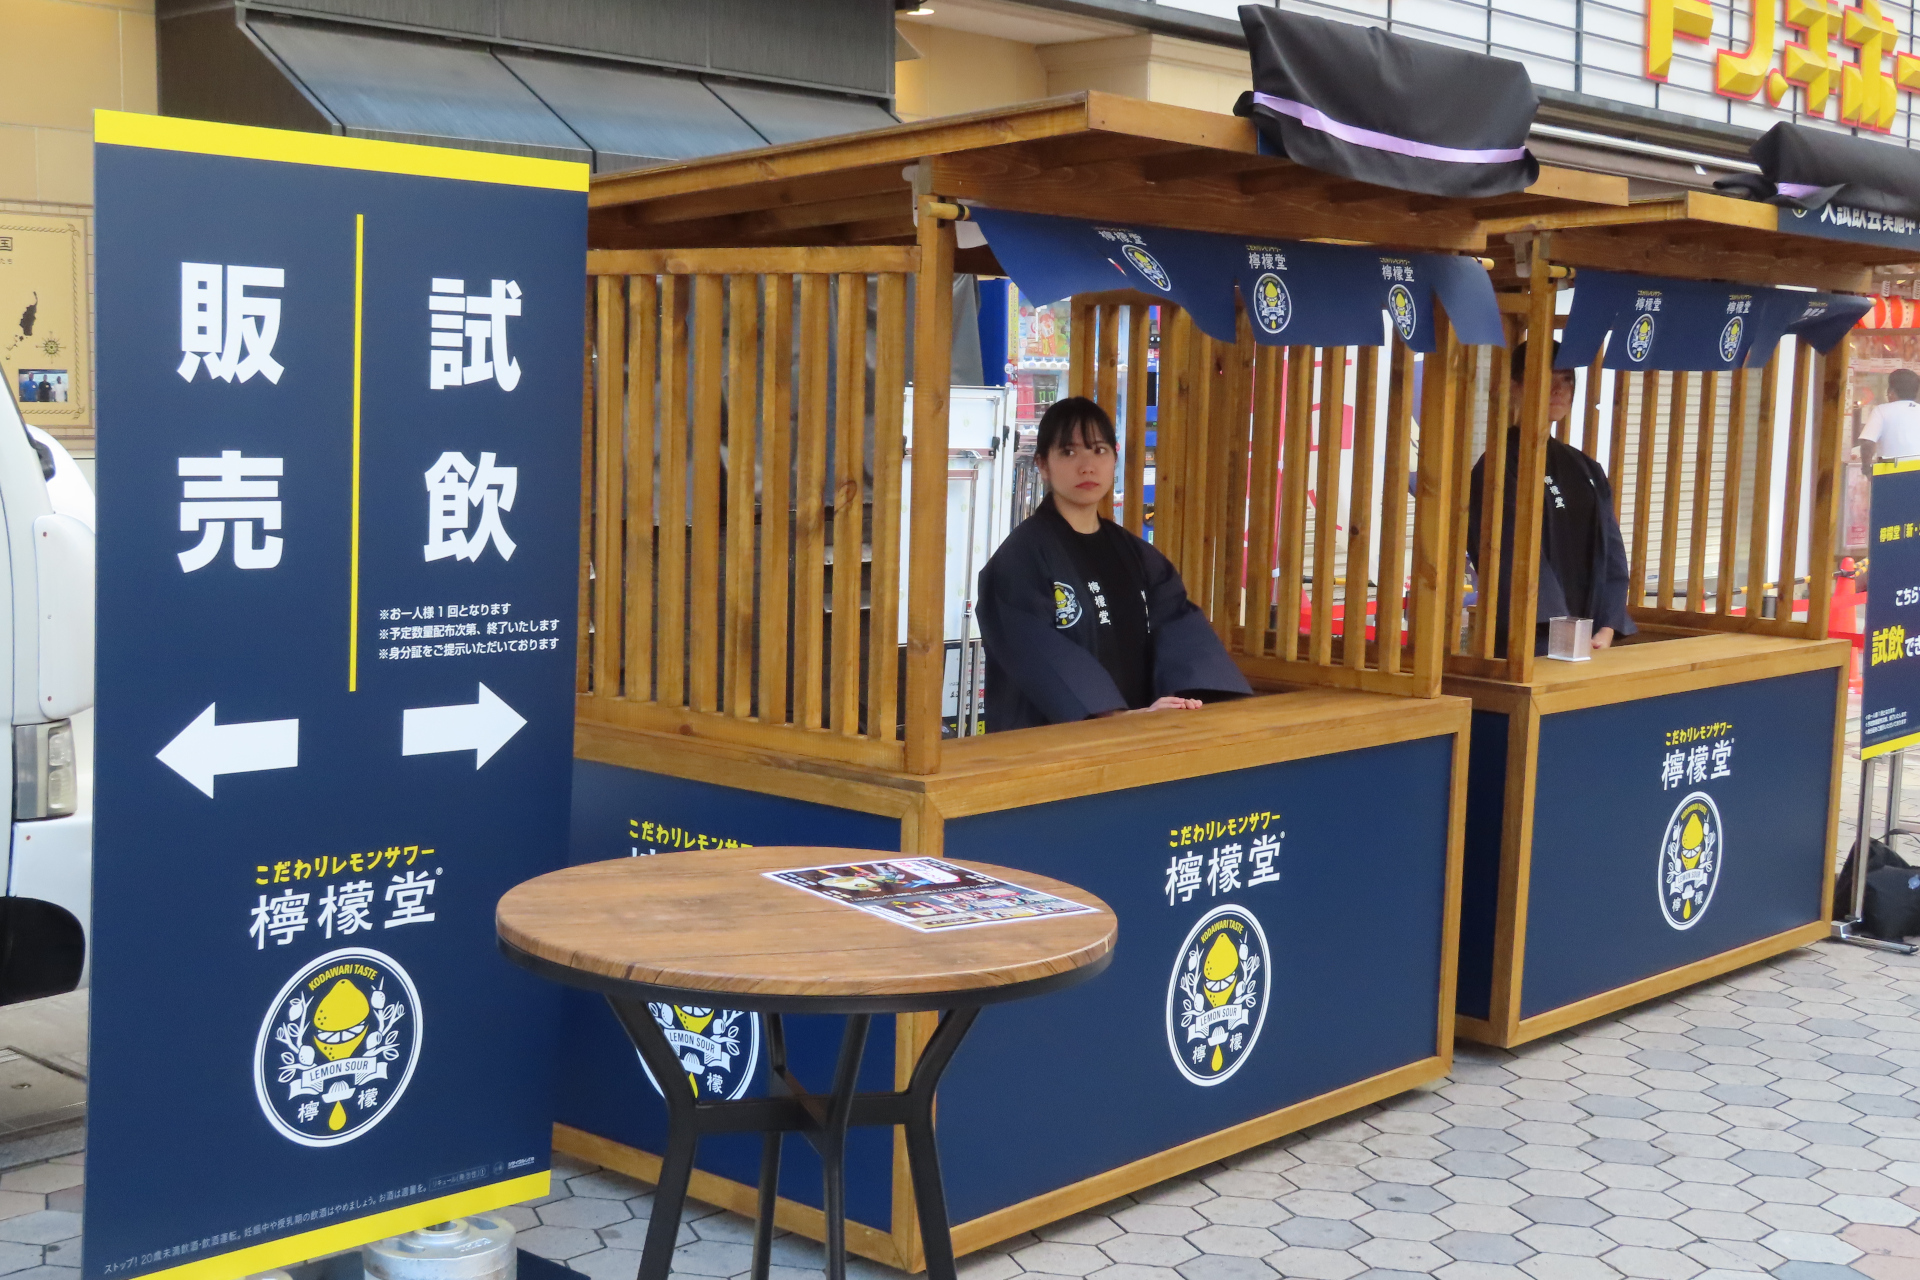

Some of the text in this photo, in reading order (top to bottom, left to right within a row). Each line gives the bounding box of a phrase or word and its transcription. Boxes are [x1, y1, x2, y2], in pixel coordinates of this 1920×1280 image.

[1249, 252, 1288, 270] 檸檬堂
[1382, 264, 1415, 282] 檸檬堂
[177, 261, 285, 573] 販売
[424, 277, 522, 563] 試飲
[1896, 586, 1920, 607] こちら
[1665, 721, 1733, 746] こだわりレモンサワー
[1169, 811, 1281, 847] こだわりレモンサワー
[255, 845, 435, 885] こだわりレモンサワー
[1200, 919, 1245, 944] KODAWARI TASTE
[308, 964, 378, 991] KODAWARI TASTE
[1200, 1008, 1237, 1026] LEMON SOUR
[669, 1032, 715, 1054] LEMON SOUR
[310, 1060, 369, 1081] LEMON SOUR
[298, 1088, 378, 1123] 檸 檬
